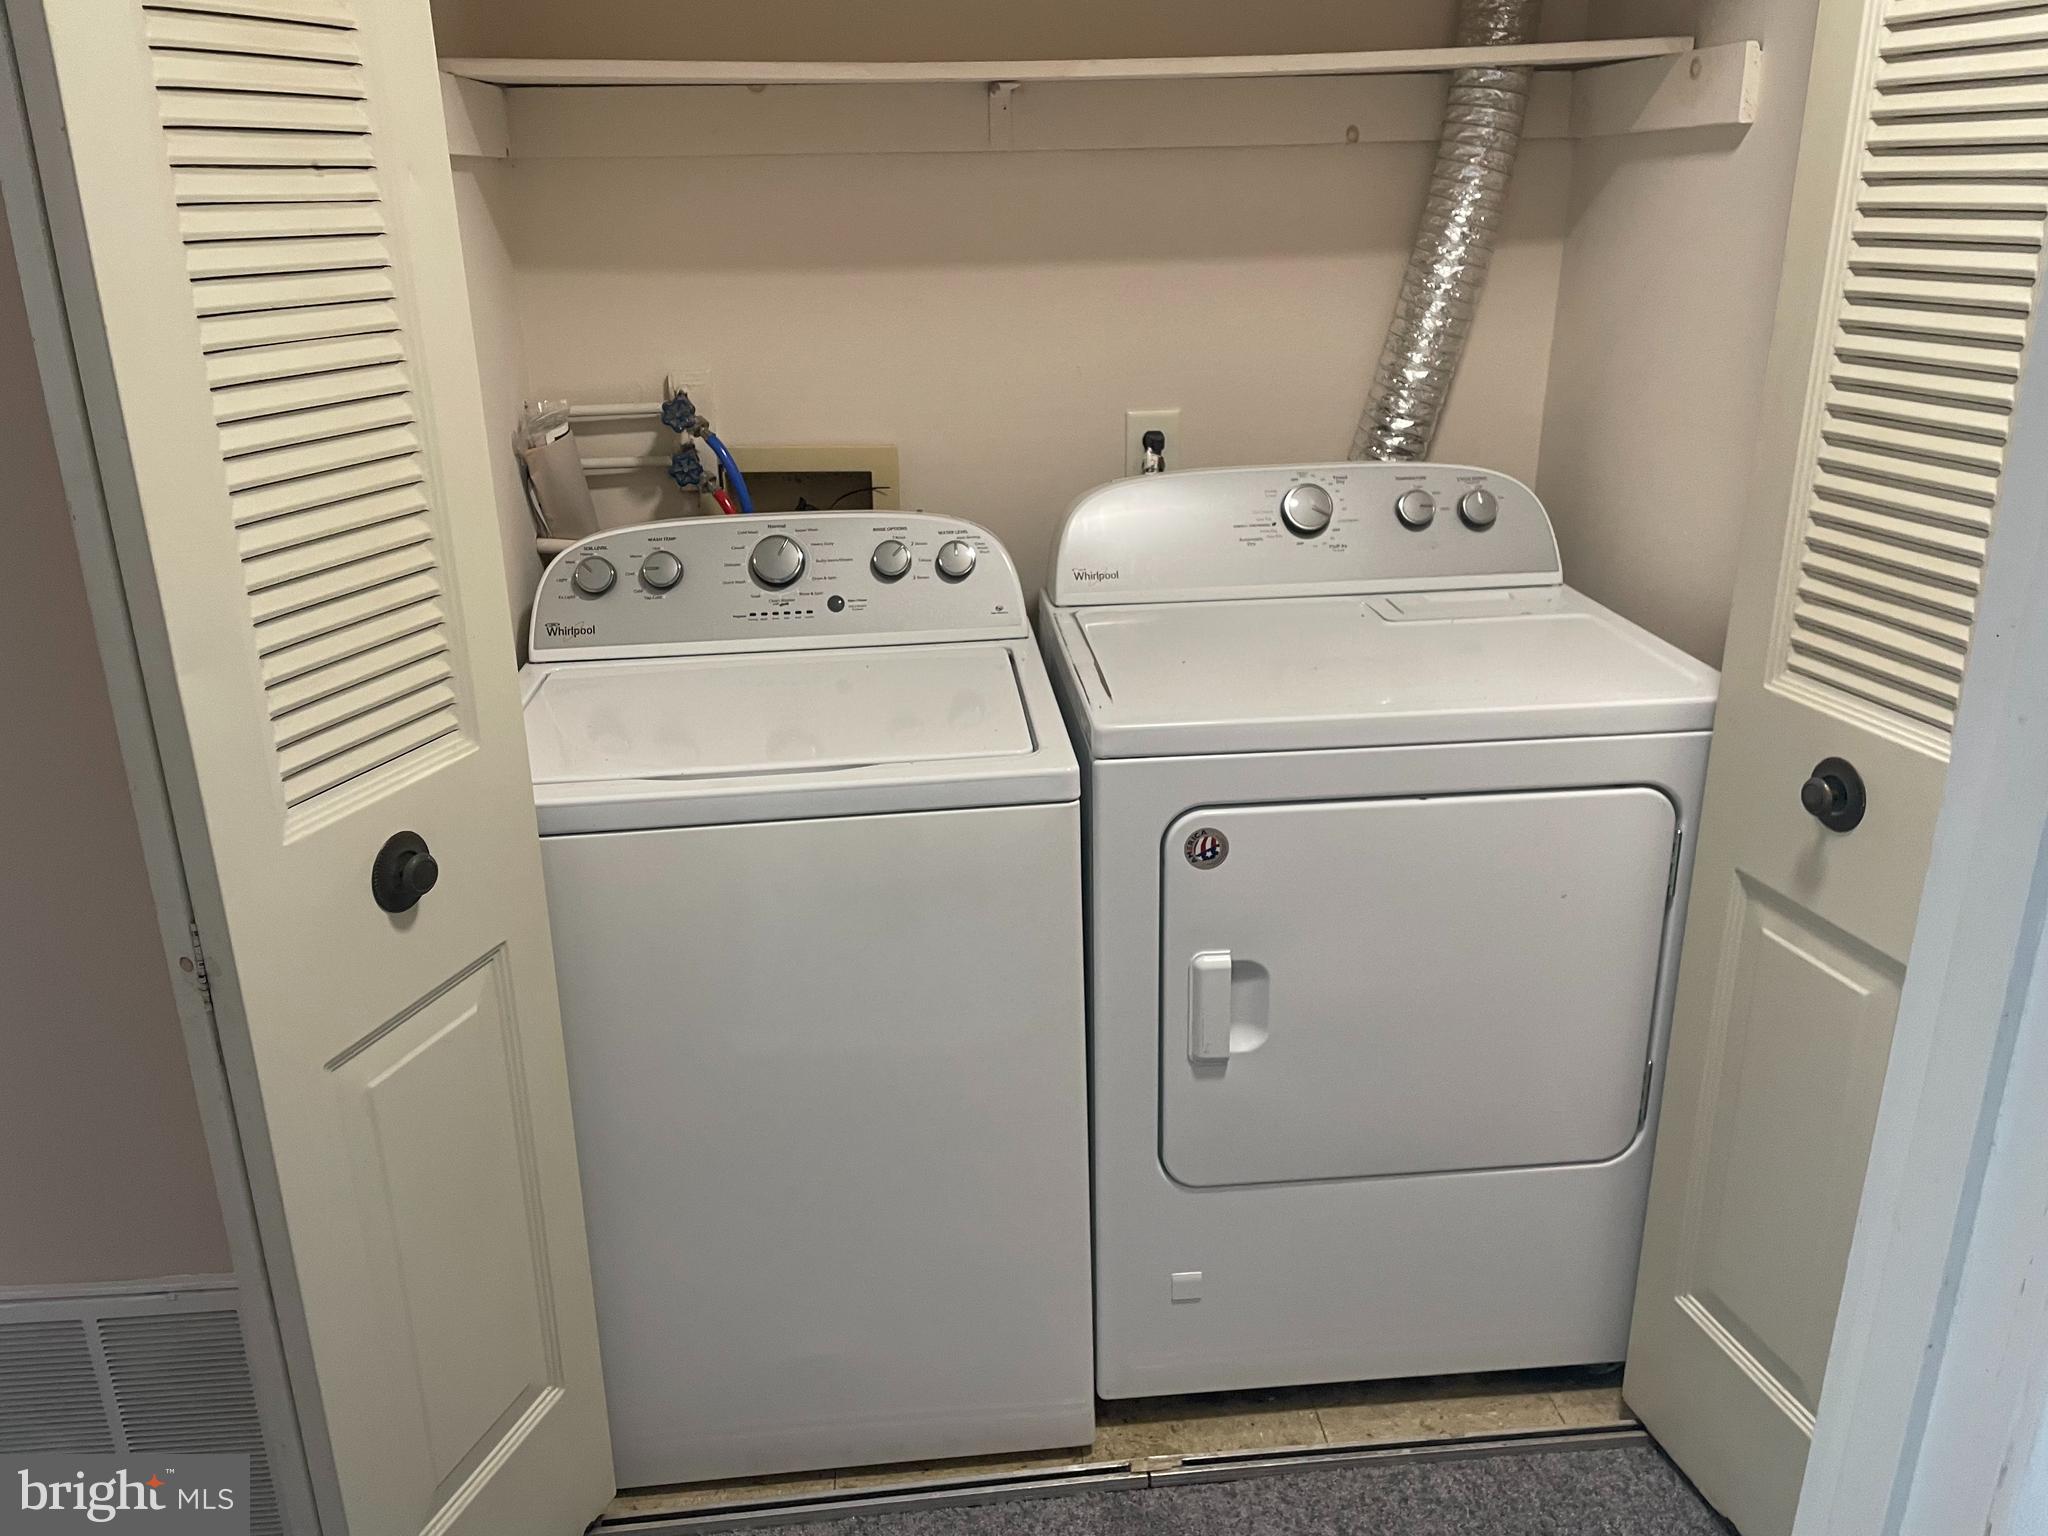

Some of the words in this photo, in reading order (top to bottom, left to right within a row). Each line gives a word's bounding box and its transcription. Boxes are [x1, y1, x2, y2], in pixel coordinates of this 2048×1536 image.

[1073, 570, 1119, 582] Whirlpool
[546, 626, 596, 638] Whirlpool
[1186, 829, 1207, 863] AMERICA
